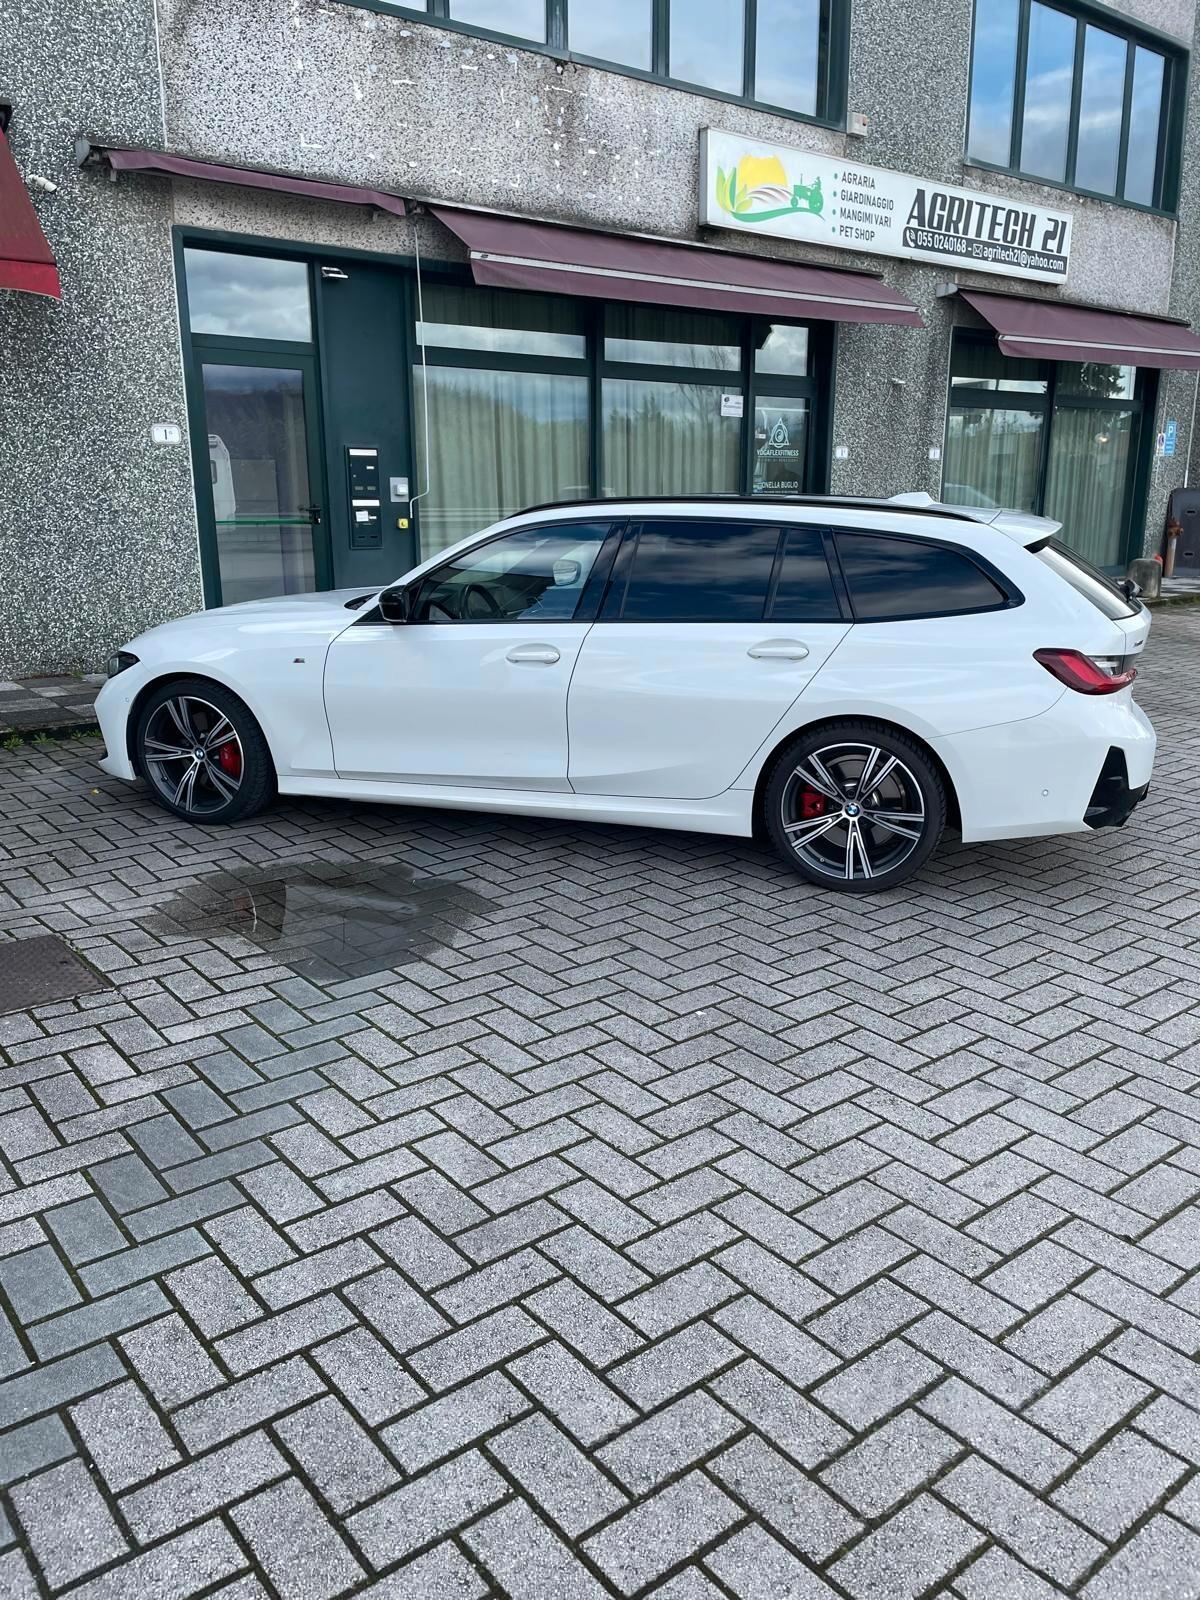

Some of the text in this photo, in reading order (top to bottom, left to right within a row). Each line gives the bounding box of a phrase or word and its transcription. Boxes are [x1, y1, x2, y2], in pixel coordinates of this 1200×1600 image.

[841, 171, 876, 189] AGRARIA
[840, 189, 895, 211] GIARDINAGGIO
[840, 207, 892, 228] MANGIMI VARI
[906, 188, 1068, 254] AGRITECH 21
[839, 225, 876, 242] PET SHOP
[917, 231, 933, 248] 055
[934, 235, 967, 254] 0240168
[983, 246, 1064, 272] agritech21@yahoo.com
